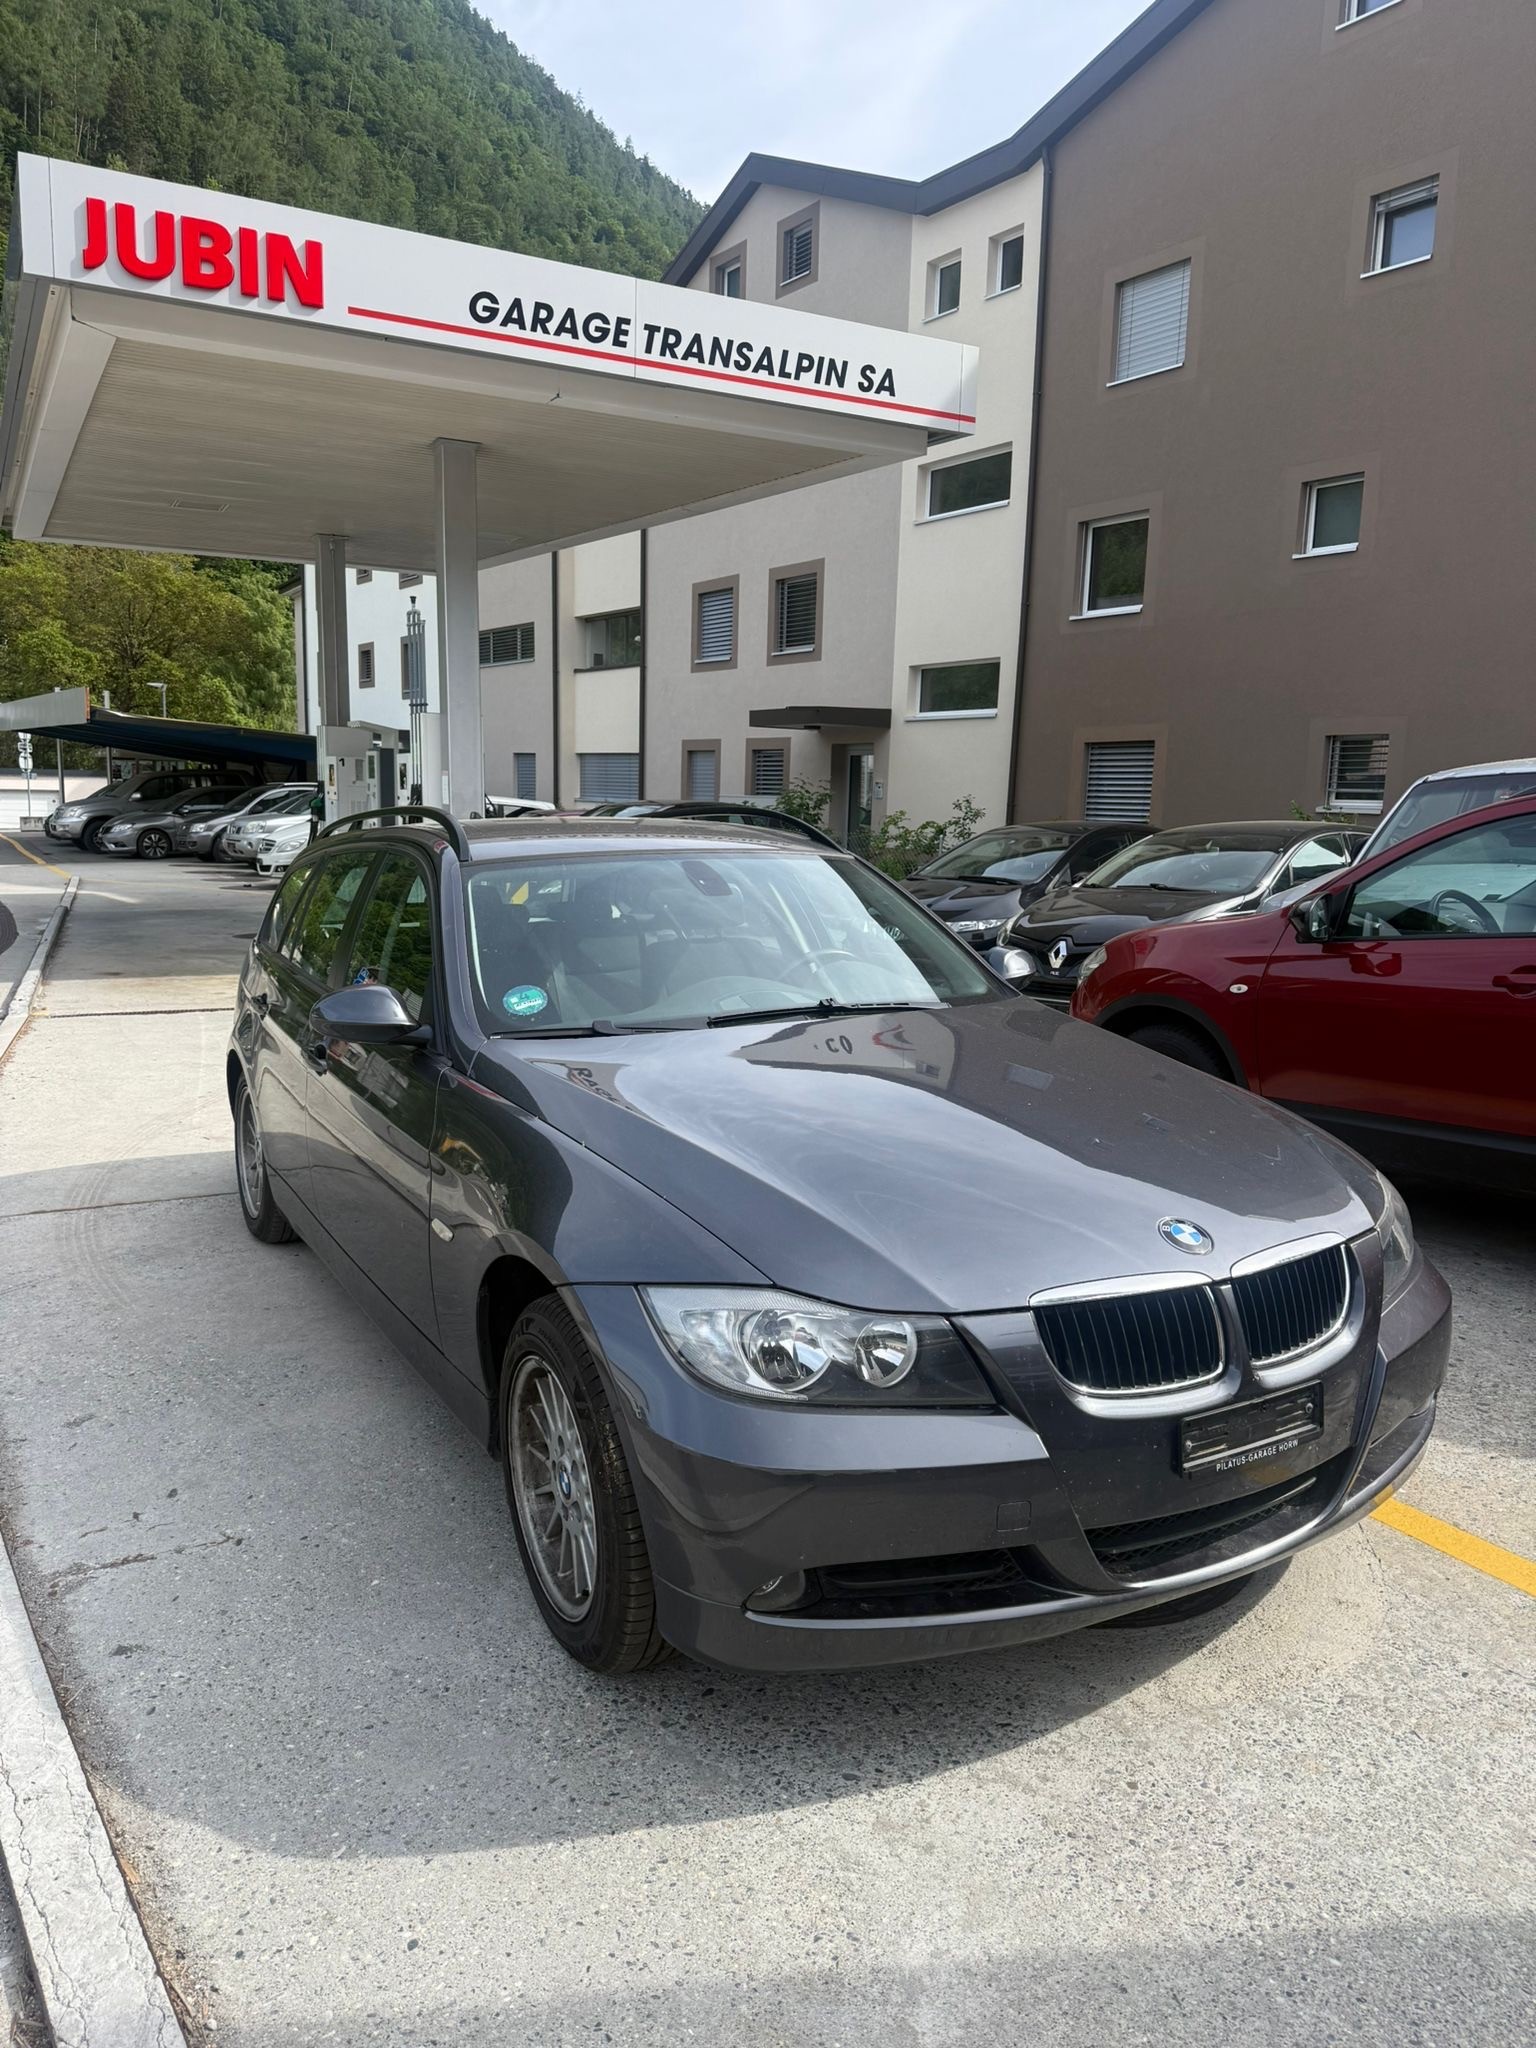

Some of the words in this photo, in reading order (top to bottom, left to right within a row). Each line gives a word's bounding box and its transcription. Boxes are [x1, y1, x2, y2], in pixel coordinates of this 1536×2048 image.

[82, 197, 324, 309] JUBIN
[469, 291, 632, 348] GARAGE
[643, 323, 849, 389] TRANSALPIN
[858, 364, 896, 397] SA
[1216, 1446, 1277, 1472] PILATUS-GARAGE
[1279, 1439, 1299, 1452] HORW
